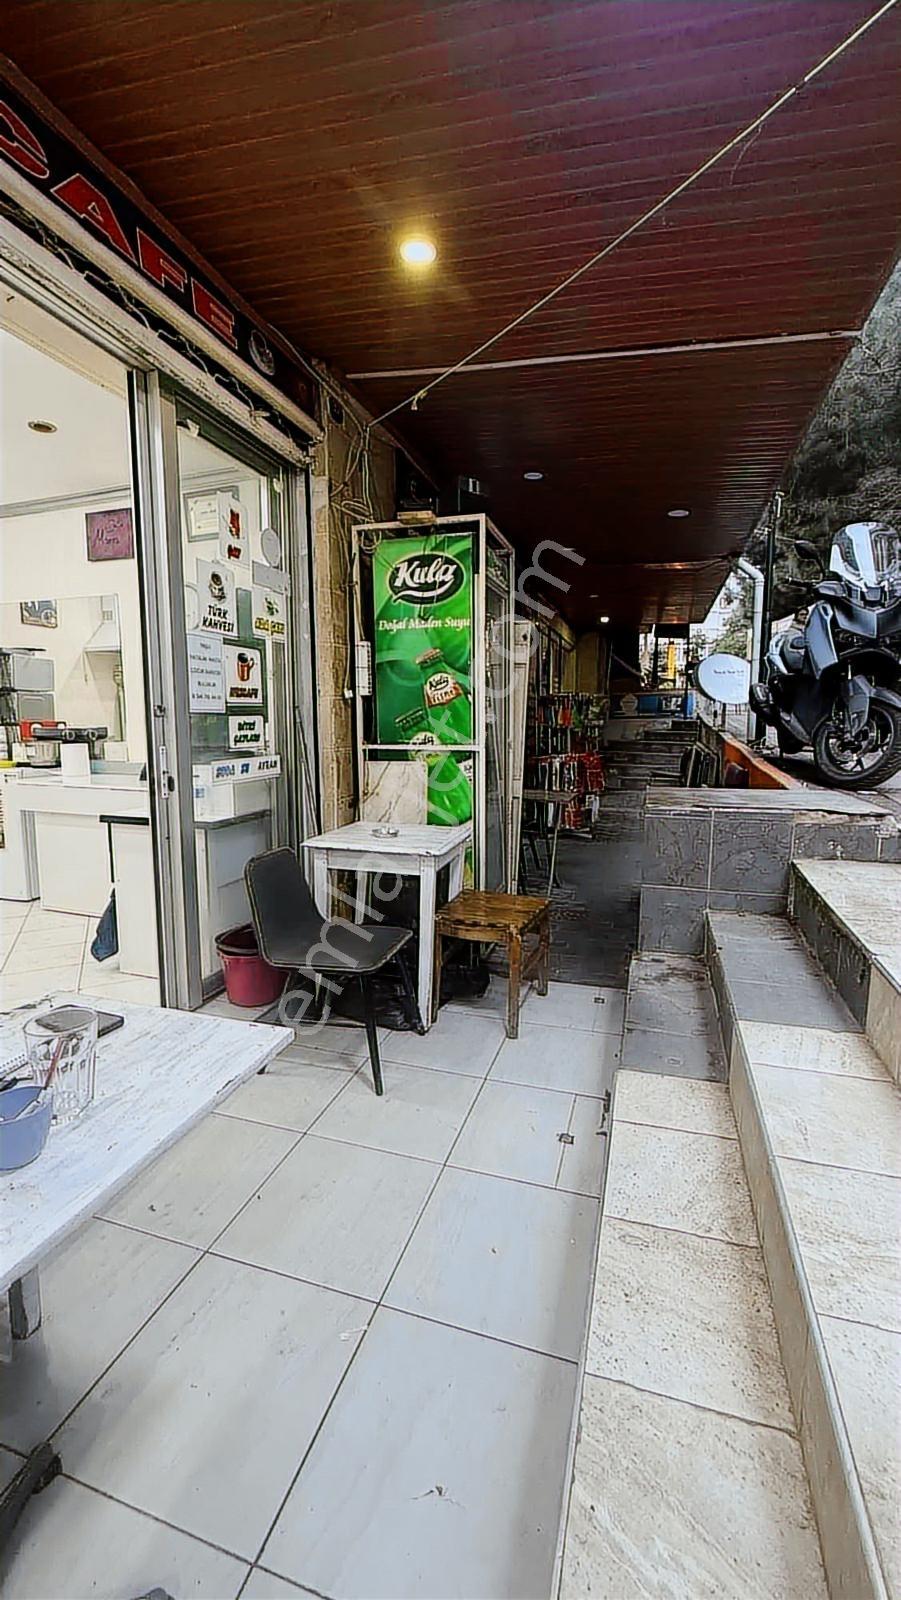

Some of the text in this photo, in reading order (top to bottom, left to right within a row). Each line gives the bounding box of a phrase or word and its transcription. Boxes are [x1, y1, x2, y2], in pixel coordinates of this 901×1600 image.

[394, 557, 457, 588] Kula
[208, 604, 228, 619] TÜRK
[378, 616, 408, 635] Doğal
[445, 617, 471, 632] Suyu
